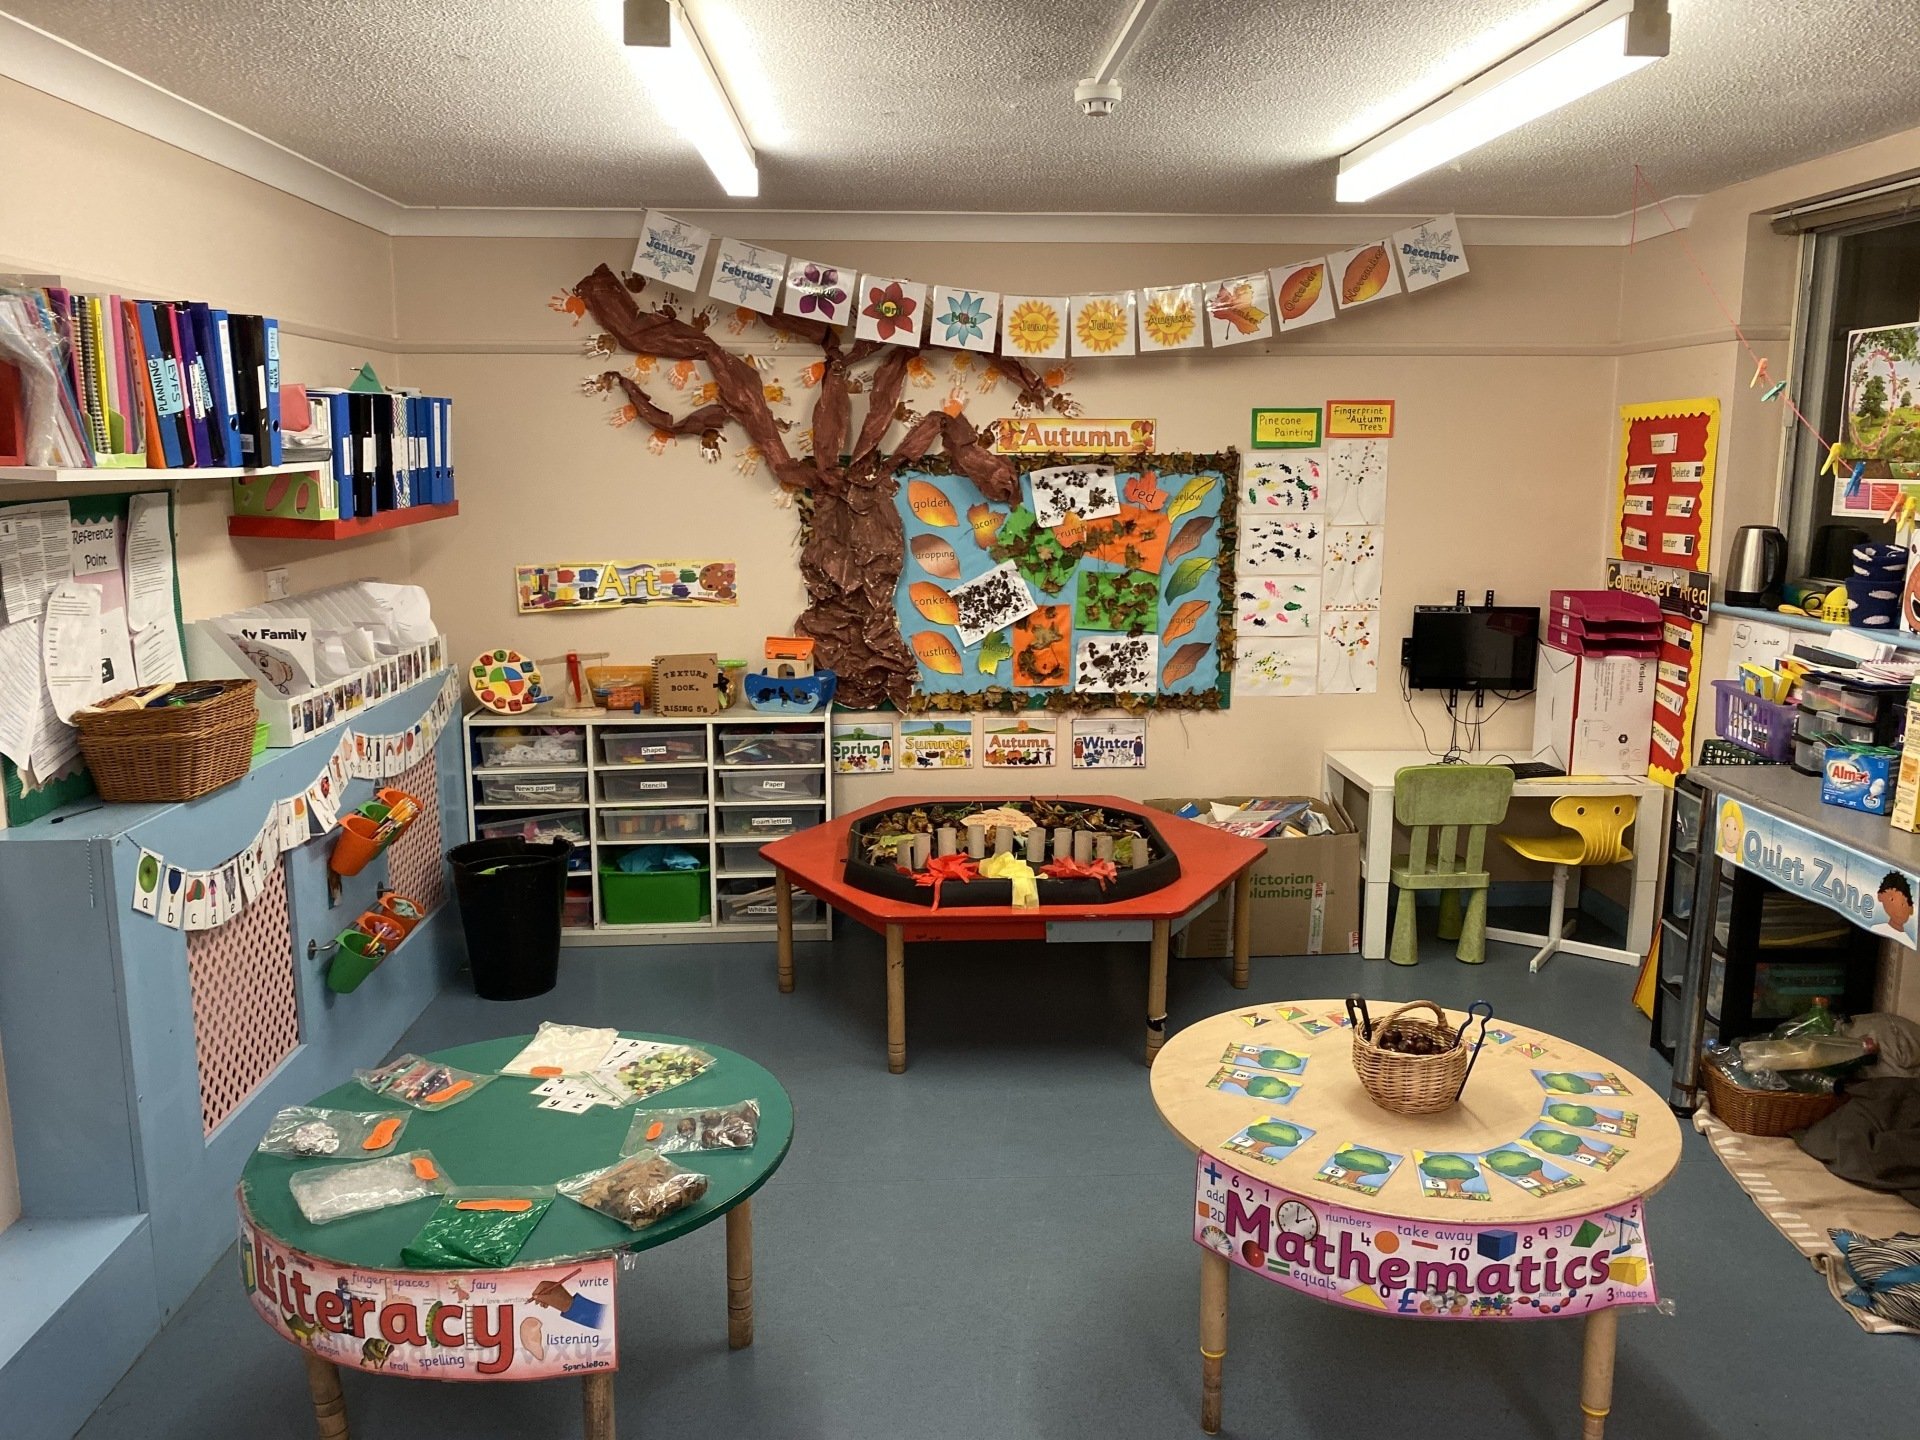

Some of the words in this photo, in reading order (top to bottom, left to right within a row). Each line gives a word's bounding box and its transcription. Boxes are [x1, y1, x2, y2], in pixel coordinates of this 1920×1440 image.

[646, 236, 696, 265] January
[1402, 243, 1460, 264] December
[722, 261, 774, 289] February
[1343, 249, 1385, 303] November
[1285, 270, 1318, 312] October
[876, 302, 905, 316] April
[951, 311, 977, 328] May
[1020, 320, 1049, 332] June
[1089, 319, 1115, 334] July
[1149, 313, 1191, 328] August
[149, 361, 168, 412] PLANNING
[168, 363, 181, 403] EYFS
[1349, 414, 1387, 424] Autumn
[1021, 422, 1131, 448] Autumn
[1274, 428, 1313, 441] Painting
[1359, 423, 1384, 432] Trees
[1672, 467, 1691, 478] Delete
[1132, 487, 1156, 504] red
[913, 497, 950, 512] golden
[973, 517, 999, 530] acorn
[72, 528, 114, 545] Reference
[84, 554, 108, 569] Point
[597, 564, 661, 597] Art
[1607, 565, 1673, 597] Computer
[1680, 581, 1710, 606] Area
[260, 629, 307, 641] Family
[918, 645, 957, 657] rustling
[663, 670, 709, 680] TEXTURE
[671, 684, 699, 692] BOOK.
[663, 705, 694, 713] RISING
[833, 741, 880, 758] Spring
[905, 736, 966, 751] Summer
[989, 735, 1050, 749] Autumn
[1083, 736, 1134, 750] Winter
[642, 746, 667, 755] Shapes
[536, 784, 555, 794] paper
[641, 782, 667, 790] Stencils
[1743, 830, 1805, 886] Quiet
[1811, 857, 1875, 918] Zone
[142, 897, 149, 910] a
[230, 903, 236, 914] e
[167, 906, 174, 924] b
[190, 912, 197, 924] c
[210, 913, 217, 925] d
[550, 1099, 562, 1108] y
[1231, 1175, 1240, 1188] 6
[1431, 1179, 1440, 1188] 5
[1206, 1189, 1225, 1204] add
[1245, 1188, 1254, 1203] 2
[1264, 1189, 1270, 1202] 1
[1210, 1207, 1226, 1224] 2D
[1629, 1204, 1638, 1218] 5
[1325, 1214, 1372, 1229] numbers
[1360, 1232, 1372, 1247] 4
[1398, 1225, 1430, 1238] take
[1434, 1231, 1473, 1246] away
[1538, 1227, 1549, 1240] 9
[1554, 1225, 1573, 1239] 3D
[1225, 1189, 1610, 1295] Mathematics
[1522, 1236, 1533, 1249] 8
[1450, 1247, 1470, 1261] 10
[351, 1272, 386, 1289] finger
[393, 1277, 430, 1291] spaces
[470, 1278, 498, 1293] fairy
[578, 1277, 609, 1288] write
[1293, 1268, 1338, 1291] equals
[1379, 1284, 1391, 1298] 0
[1606, 1287, 1614, 1302] 3
[1615, 1288, 1648, 1300] shapes
[253, 1228, 515, 1375] Literacy
[1585, 1294, 1594, 1308] 7
[546, 1333, 600, 1348] listening
[389, 1361, 409, 1372] troll
[418, 1355, 466, 1370] spelling
